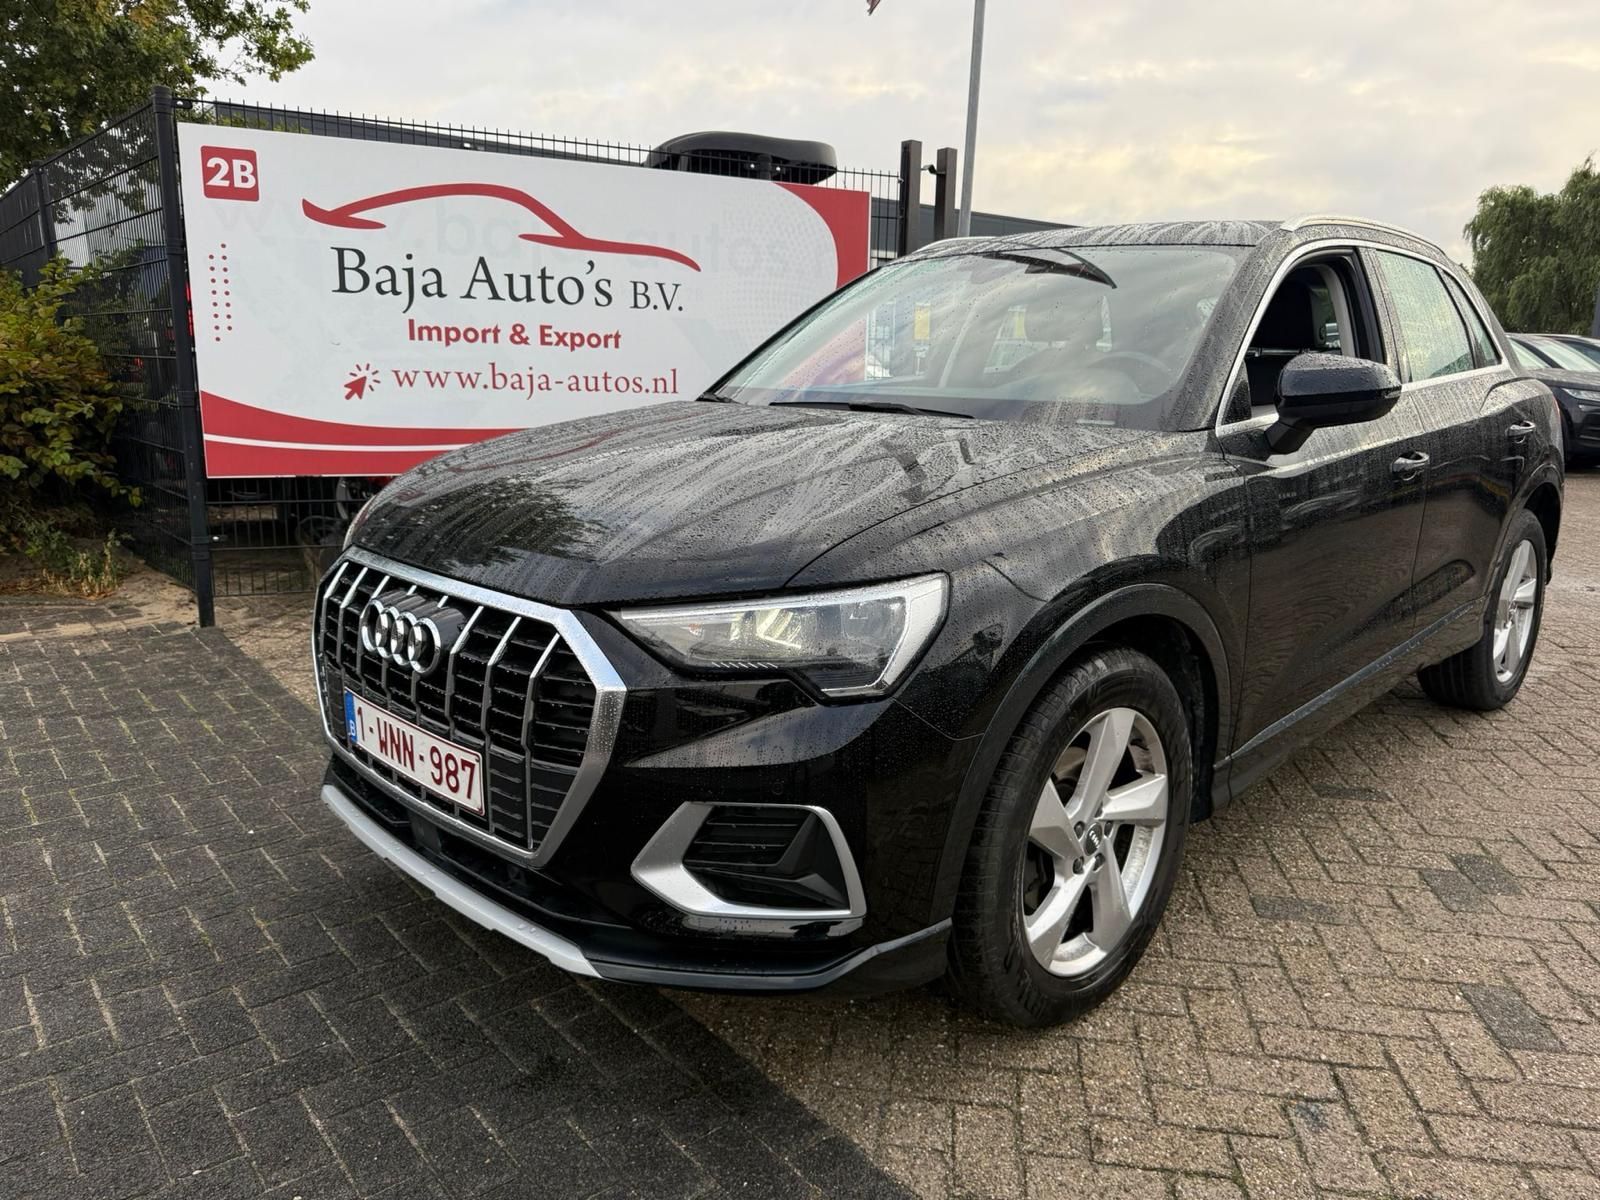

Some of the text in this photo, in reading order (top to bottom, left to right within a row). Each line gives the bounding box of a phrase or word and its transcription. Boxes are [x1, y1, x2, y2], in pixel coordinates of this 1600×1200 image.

[206, 157, 256, 189] 2B
[331, 246, 448, 314] Baja
[629, 280, 684, 312] B.V.
[408, 318, 622, 353] Import & Export
[391, 361, 679, 401] www.baja-autos.nl
[356, 705, 476, 800] 1-WNN-987
